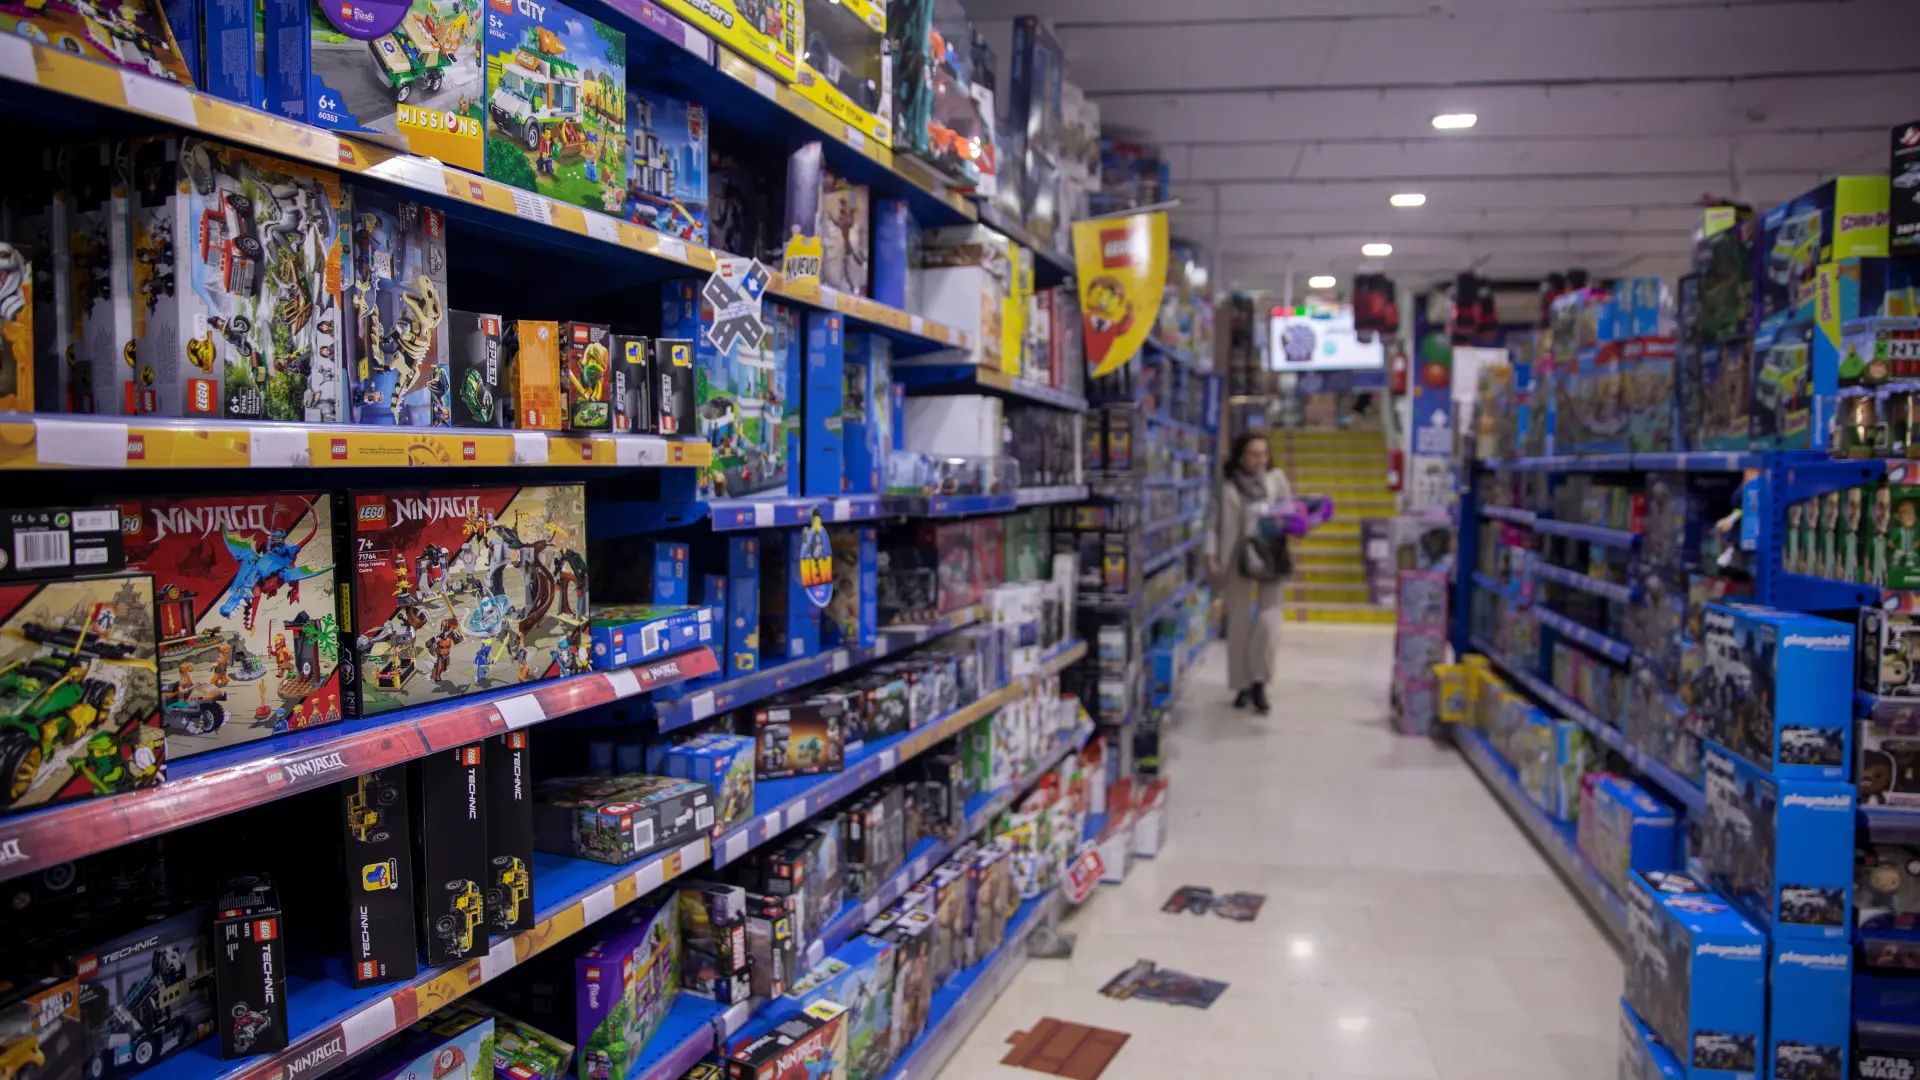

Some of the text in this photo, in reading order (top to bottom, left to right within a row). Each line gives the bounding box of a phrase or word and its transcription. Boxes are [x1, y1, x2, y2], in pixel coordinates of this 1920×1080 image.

[489, 14, 504, 28] 5+
[517, 0, 546, 22] CITY
[318, 95, 336, 110] 6+
[318, 111, 338, 123] 60353
[398, 107, 478, 136] MISSIONS
[340, 150, 353, 158] LEGO
[429, 211, 439, 237] LEGO
[787, 257, 820, 281] NUEVO
[489, 340, 497, 387] SPEED
[197, 381, 209, 409] LEGO
[616, 371, 626, 411] SPEED
[662, 373, 672, 413] SPEED
[230, 396, 240, 413] 6+
[128, 442, 143, 452] EGO
[332, 445, 346, 453] LEGO
[463, 447, 475, 456] LEGO
[122, 505, 272, 543] GO NINJAGO
[360, 496, 480, 527] LEGO NINJAGO
[358, 539, 374, 551] 7+
[266, 752, 349, 784] LEGO NINJAGO
[468, 749, 476, 765] LEGO
[514, 751, 522, 800] TECHNIC
[468, 768, 476, 819] TECHNIC
[261, 921, 270, 939] LEGO
[360, 905, 371, 958] TECHNIC
[80, 936, 158, 973] LEGO TECHNIC
[262, 944, 274, 1003] TECHNIC
[364, 962, 372, 978] LEGO
[287, 1036, 344, 1080] NINJAGO
[1866, 1056, 1910, 1068] STAR
